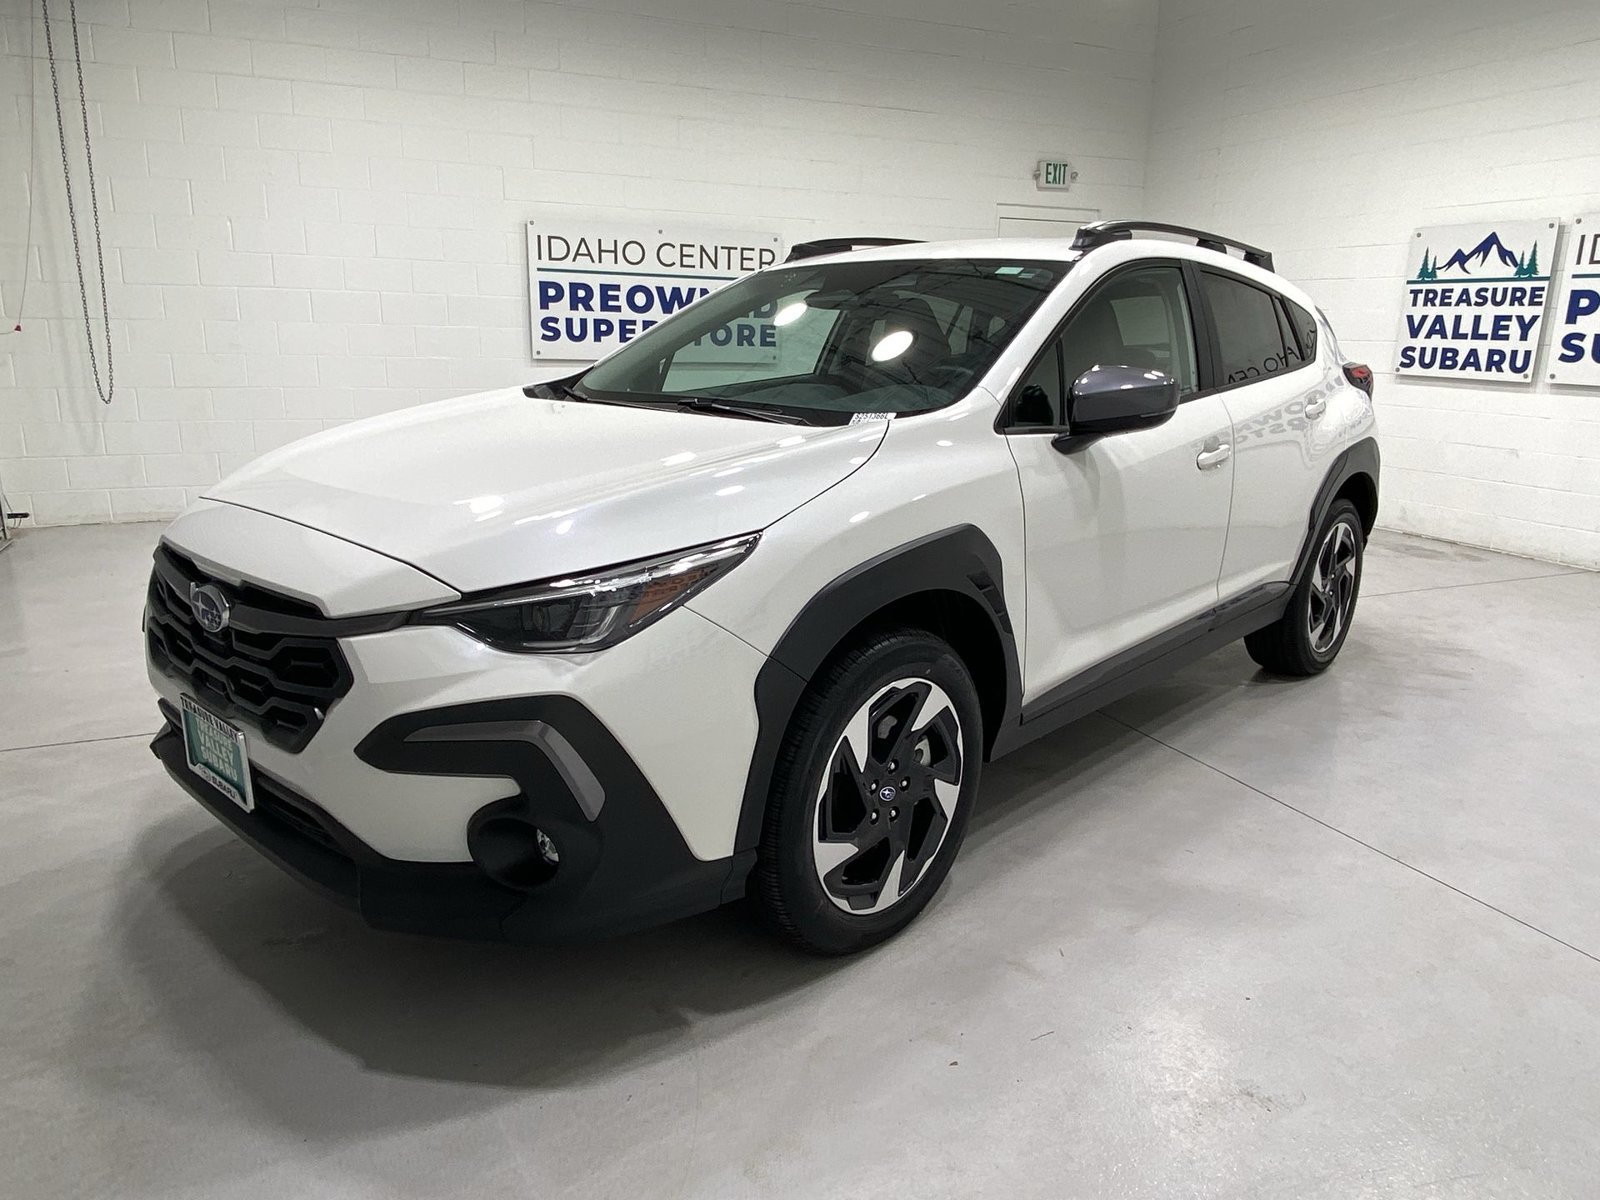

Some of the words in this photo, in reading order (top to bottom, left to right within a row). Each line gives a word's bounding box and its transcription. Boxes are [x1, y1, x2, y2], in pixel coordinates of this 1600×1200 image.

[1045, 162, 1068, 185] EXIT
[536, 234, 646, 265] IDAHO
[656, 242, 776, 271] CENTER
[1409, 286, 1545, 307] TREASURE
[1406, 314, 1541, 342] VALLEY
[1398, 345, 1533, 374] SUBARU
